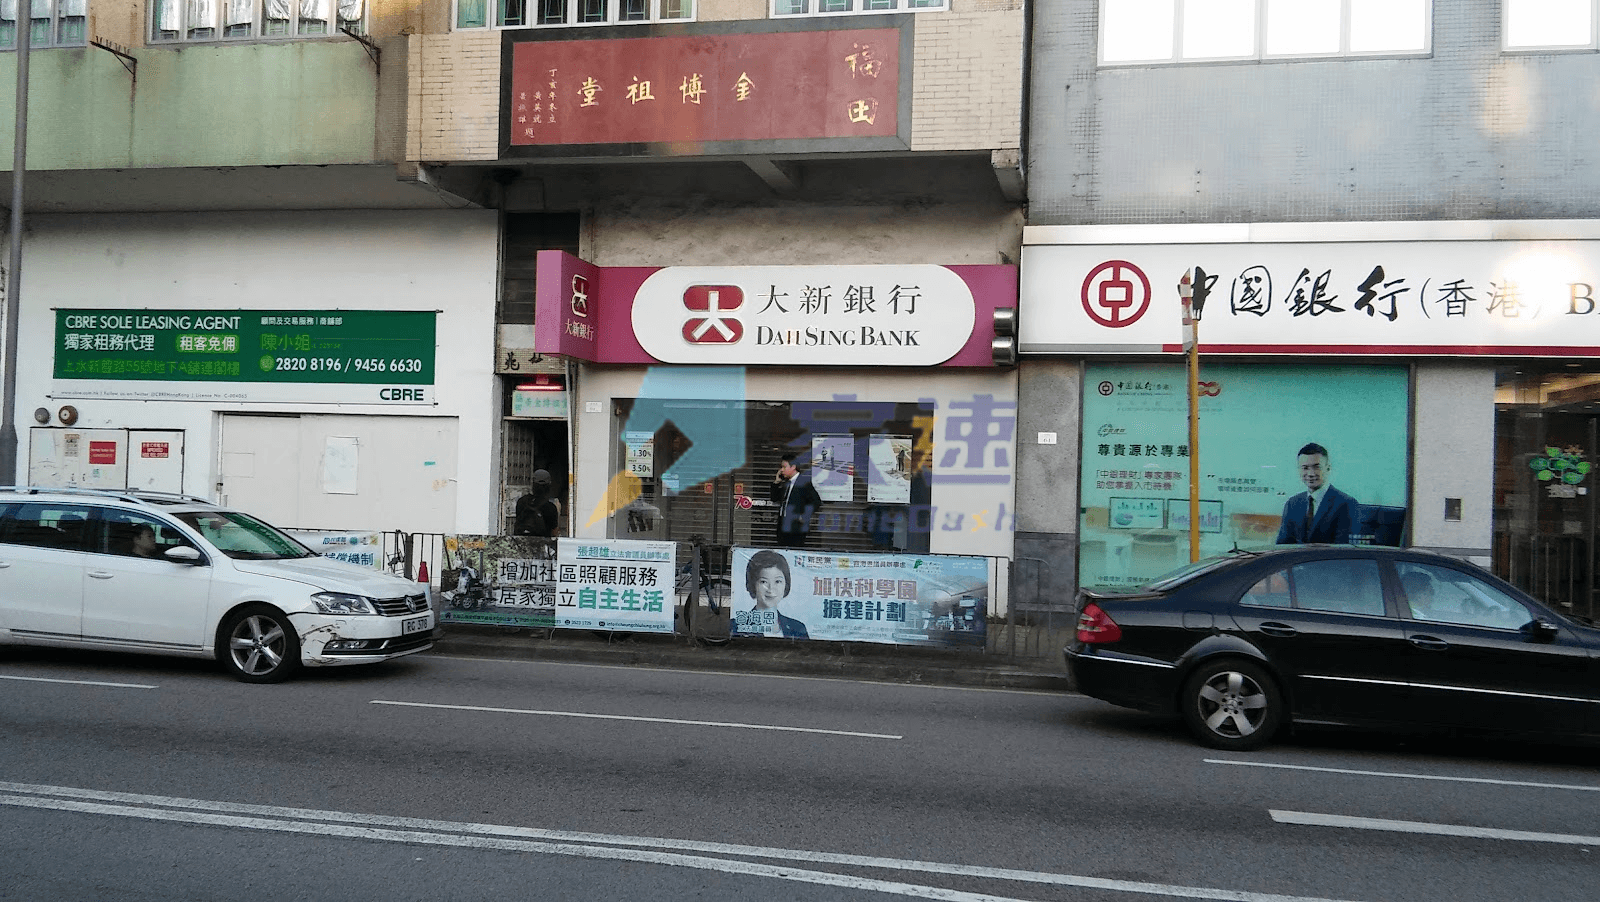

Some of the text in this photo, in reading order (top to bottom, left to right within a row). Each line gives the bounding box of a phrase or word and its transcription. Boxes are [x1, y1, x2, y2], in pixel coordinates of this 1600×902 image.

[755, 284, 923, 316] 大新銀行
[1565, 282, 1600, 316] B
[65, 315, 242, 331] CBRE SOLE LEASING AGENT
[564, 318, 594, 342] 大新銀行
[64, 332, 237, 352] 獨家租務代理 租客免佣
[260, 332, 311, 352] 陳小姐
[805, 325, 857, 347] SING
[859, 325, 921, 347] BANK
[275, 357, 422, 374] 2820 8196 / 9456 6630
[379, 388, 425, 401] CBRE
[1097, 443, 1190, 458] 尊貴源於專業
[807, 555, 832, 566] 新民黨
[500, 561, 658, 587] 增加社區照顧服務
[499, 586, 664, 613] 居家獨立自主生活
[812, 576, 918, 602] 加快科學園
[735, 610, 775, 626] 容海恩
[822, 598, 906, 623] 擴建計劃
